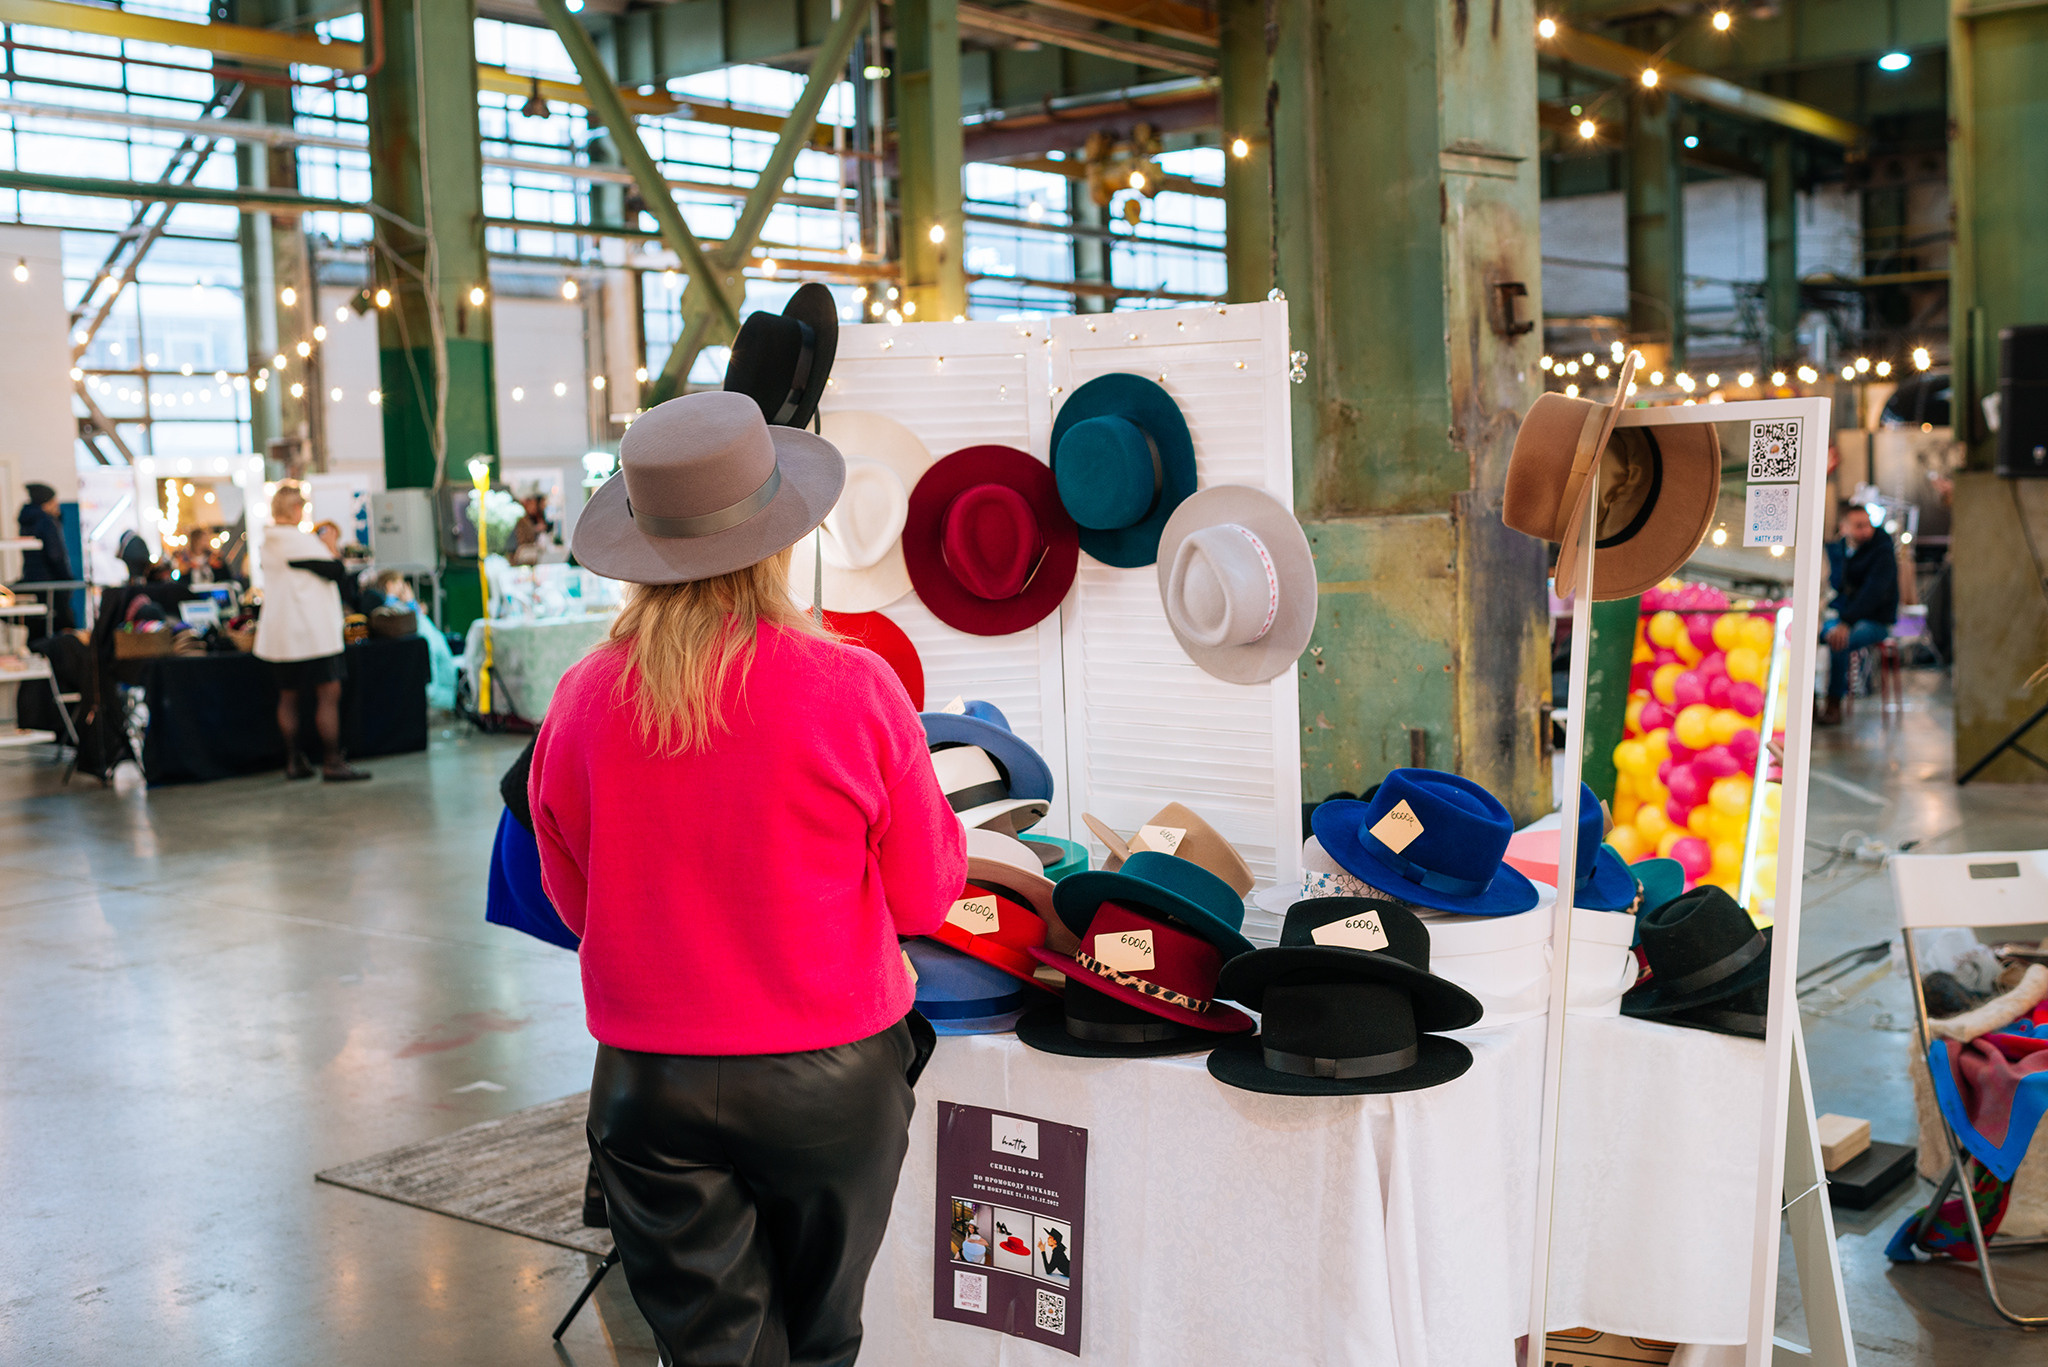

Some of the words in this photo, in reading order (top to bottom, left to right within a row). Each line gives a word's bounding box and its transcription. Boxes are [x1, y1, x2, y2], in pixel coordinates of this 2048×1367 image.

[989, 1162, 1016, 1173] СКИДКА
[1030, 1170, 1044, 1179] РУБ
[984, 1176, 1024, 1190] ПРОМОКОДУ
[986, 1185, 1014, 1196] ПОКУПКЕ
